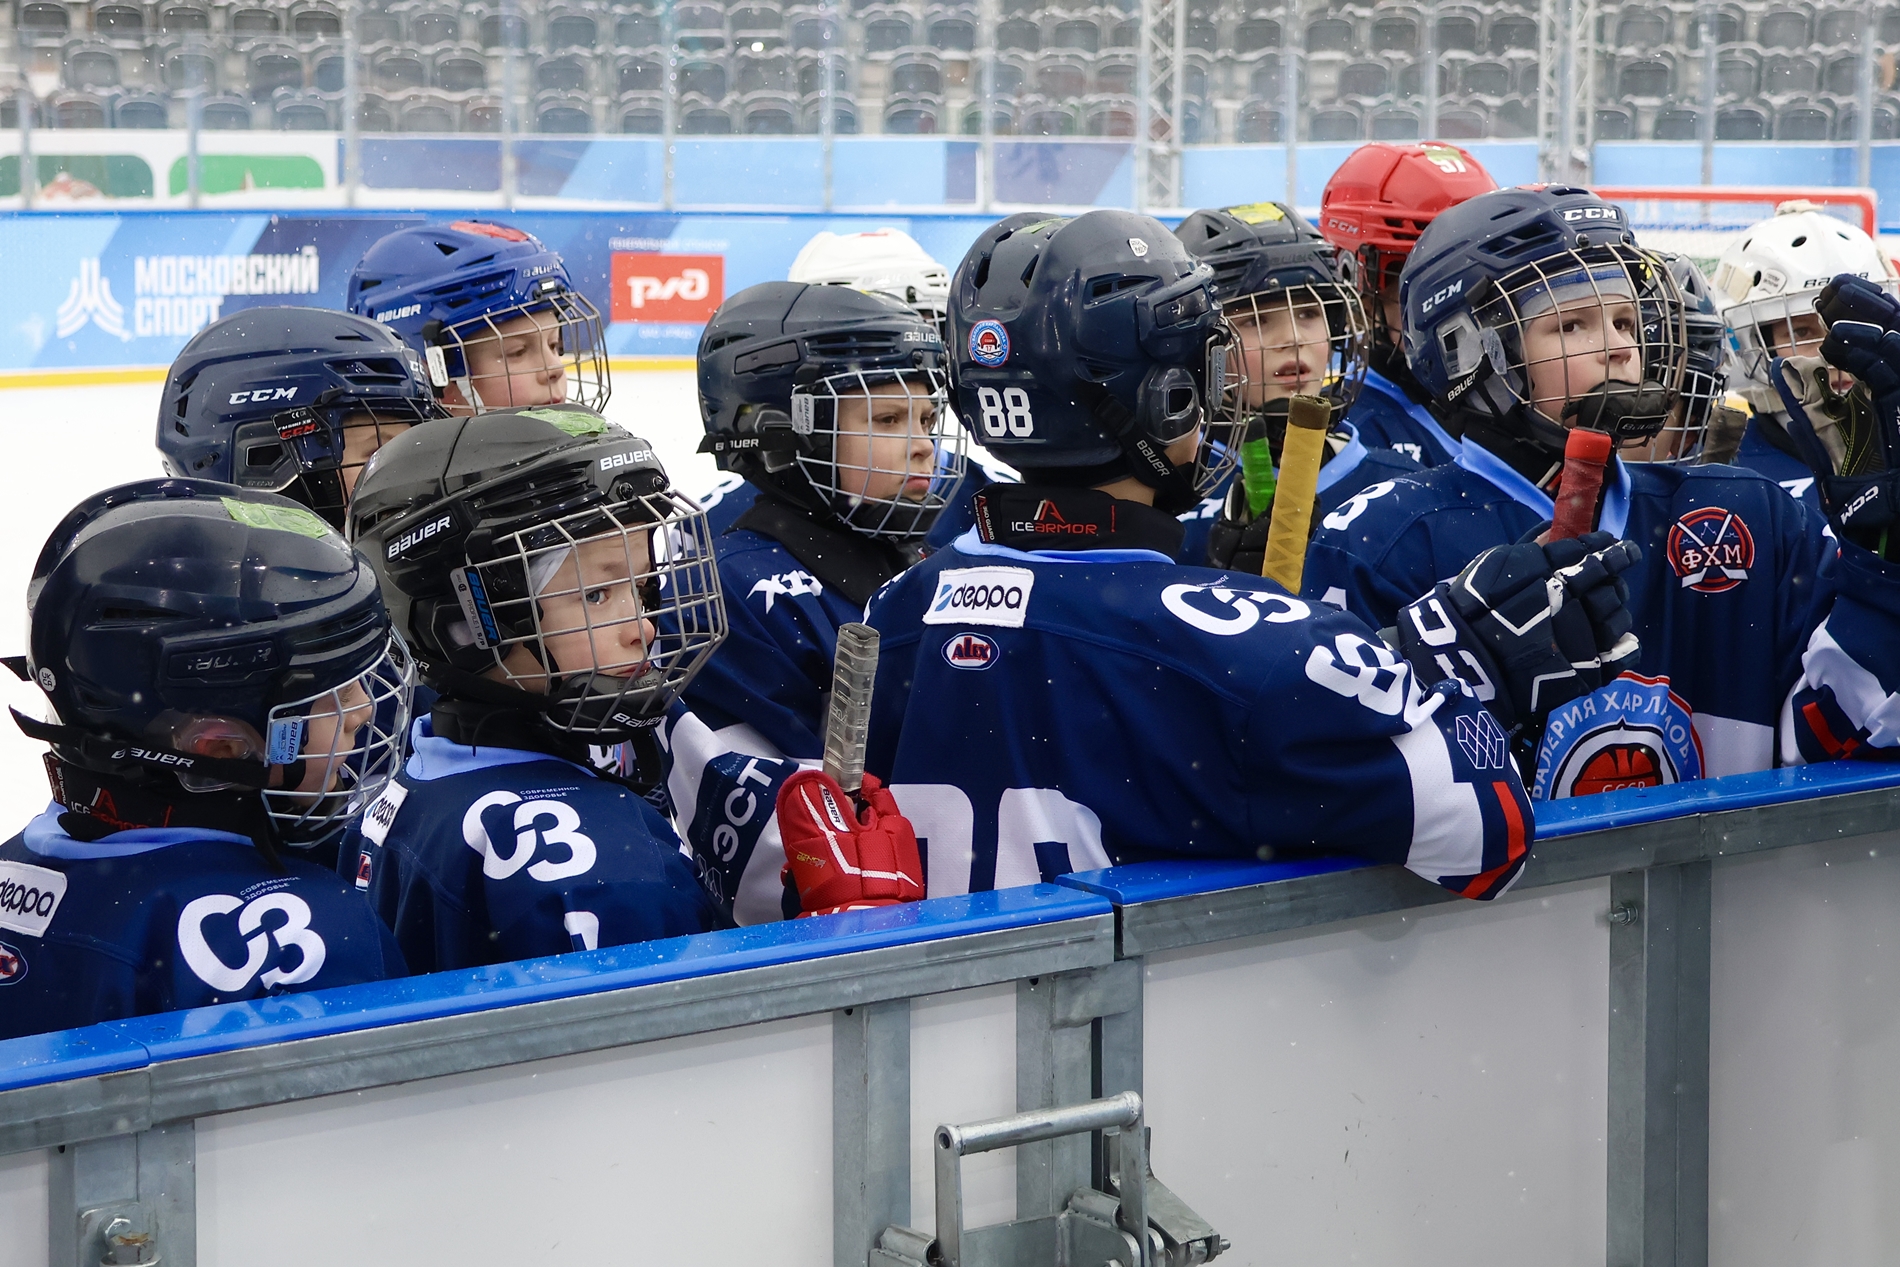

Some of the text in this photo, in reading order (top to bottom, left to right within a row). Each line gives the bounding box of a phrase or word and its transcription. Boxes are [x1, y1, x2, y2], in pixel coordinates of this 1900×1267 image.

[1327, 217, 1360, 236] CCM
[1561, 207, 1618, 222] CCM
[134, 245, 320, 296] МОСКОВСКИЙ
[1803, 272, 1869, 288] BAR
[1421, 278, 1463, 314] CCM
[134, 296, 225, 337] СПОРТ
[376, 303, 422, 325] BAUER
[903, 331, 941, 344] BAUER
[228, 386, 298, 405] CCM
[1447, 369, 1479, 402] BAUER
[977, 386, 1034, 437] 88
[281, 423, 316, 438] CCM
[600, 449, 653, 472] BAUER
[1136, 439, 1171, 477] BAUER
[1840, 485, 1880, 526] CCM
[388, 515, 451, 560] BAUER
[1681, 544, 1742, 570] ФХМ
[467, 571, 498, 640] BAUER
[951, 583, 1022, 611] deppa
[287, 721, 299, 761] BAUER
[823, 788, 840, 823] BAUER
